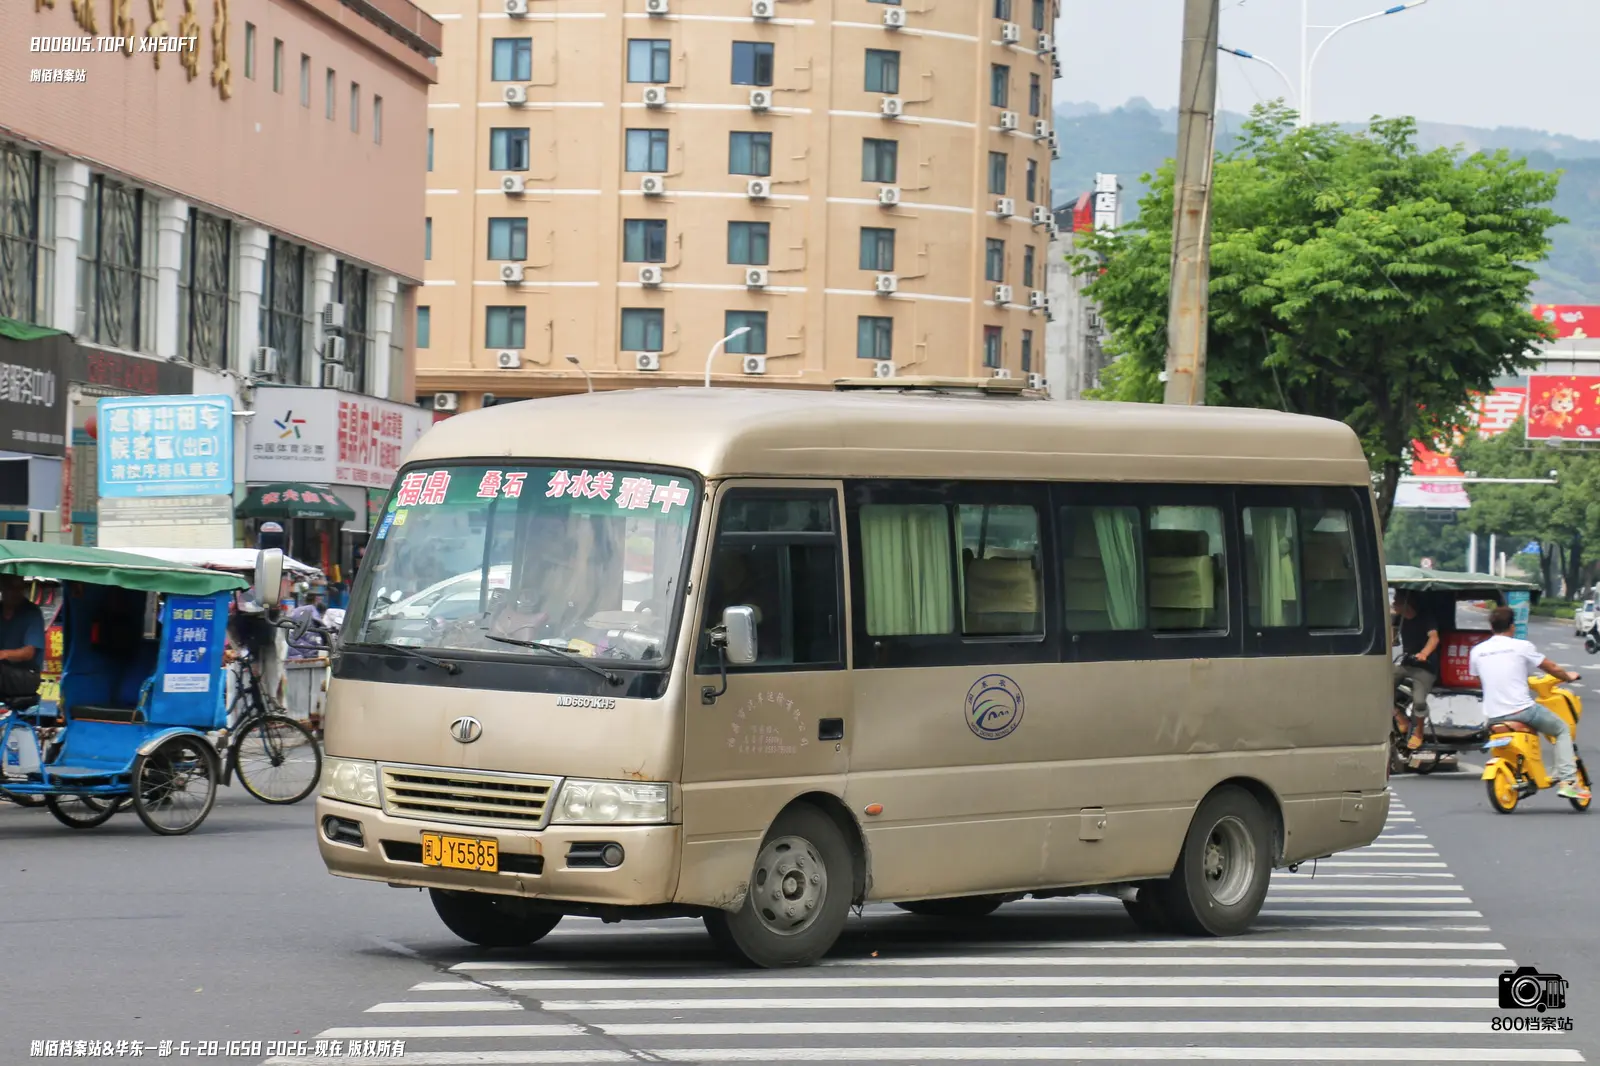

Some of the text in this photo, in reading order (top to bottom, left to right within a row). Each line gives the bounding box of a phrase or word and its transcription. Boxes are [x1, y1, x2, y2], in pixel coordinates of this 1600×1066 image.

[253, 442, 325, 455] 中国体育彩票
[396, 470, 451, 506] 福鼎
[476, 470, 528, 499] 叠石
[545, 470, 615, 501] 分水关
[615, 476, 690, 514] 雅中
[556, 696, 616, 709] MD6601KH5
